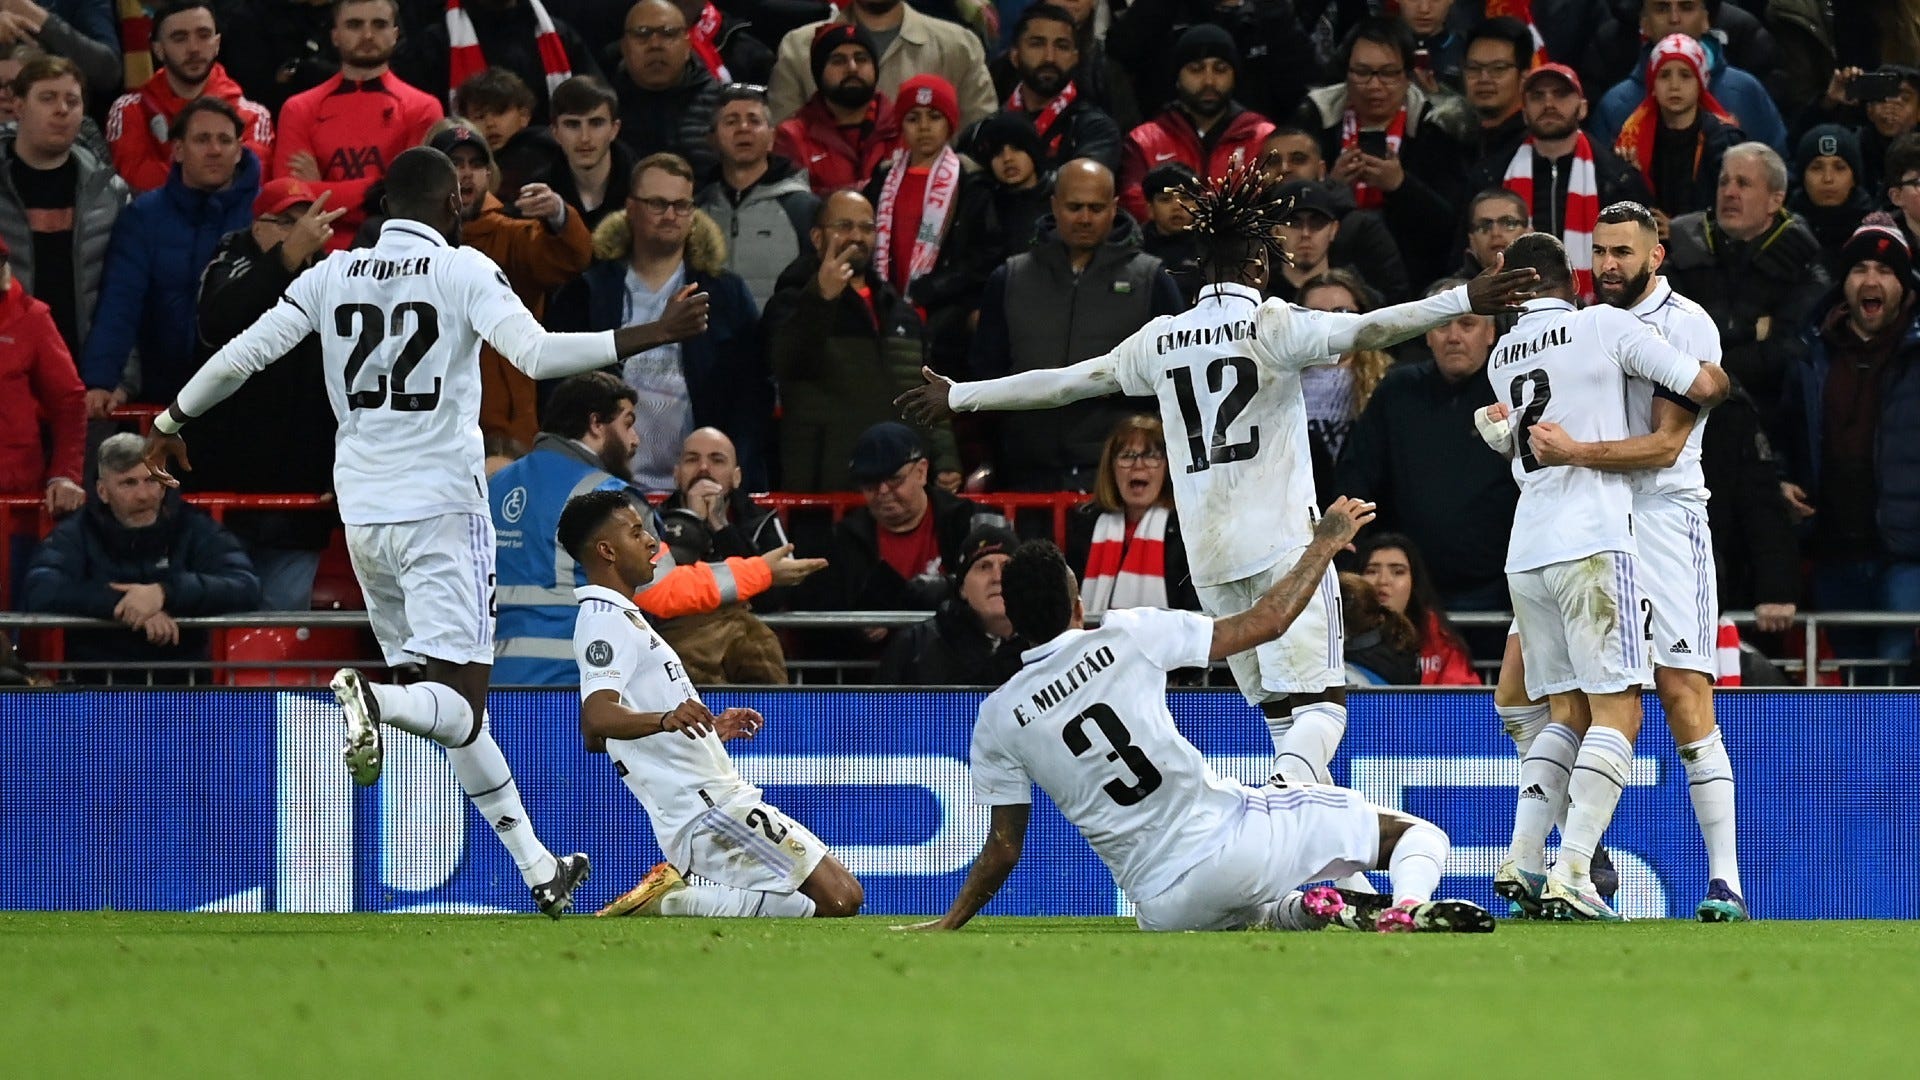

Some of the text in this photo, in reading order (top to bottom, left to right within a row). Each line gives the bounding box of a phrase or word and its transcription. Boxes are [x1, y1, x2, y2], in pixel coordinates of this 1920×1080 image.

[324, 146, 385, 181] AXA
[334, 302, 442, 411] 22
[1156, 320, 1257, 355] CAMAVINGA
[1494, 327, 1572, 369] CARVAJAL
[1166, 356, 1260, 474] 12
[1510, 368, 1552, 474] 2
[1013, 703, 1036, 728] E.
[1062, 702, 1163, 807] 3
